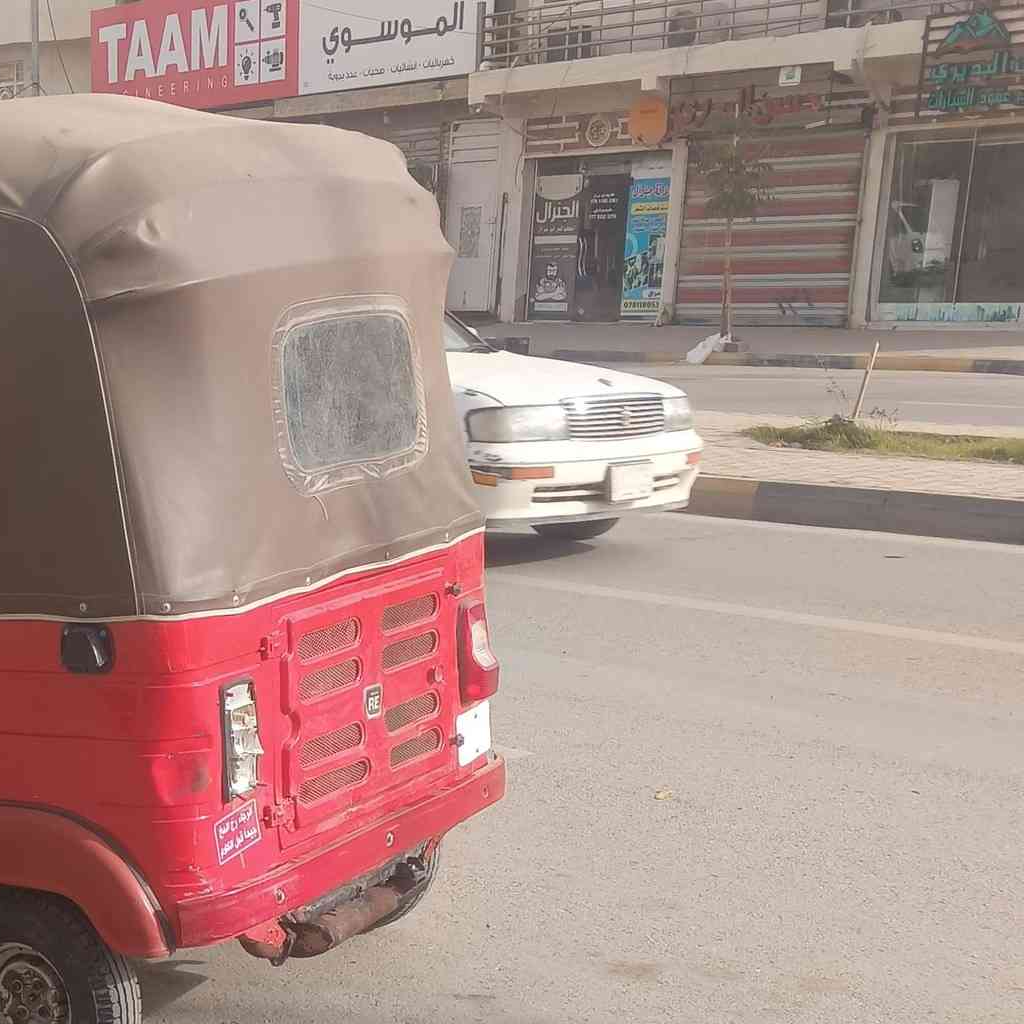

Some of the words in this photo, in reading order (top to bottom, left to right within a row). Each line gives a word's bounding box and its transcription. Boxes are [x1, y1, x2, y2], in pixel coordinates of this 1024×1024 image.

[98, 4, 228, 84] TAAM
[322, 1, 465, 64] الموسوي
[536, 199, 580, 223] الجنرال
